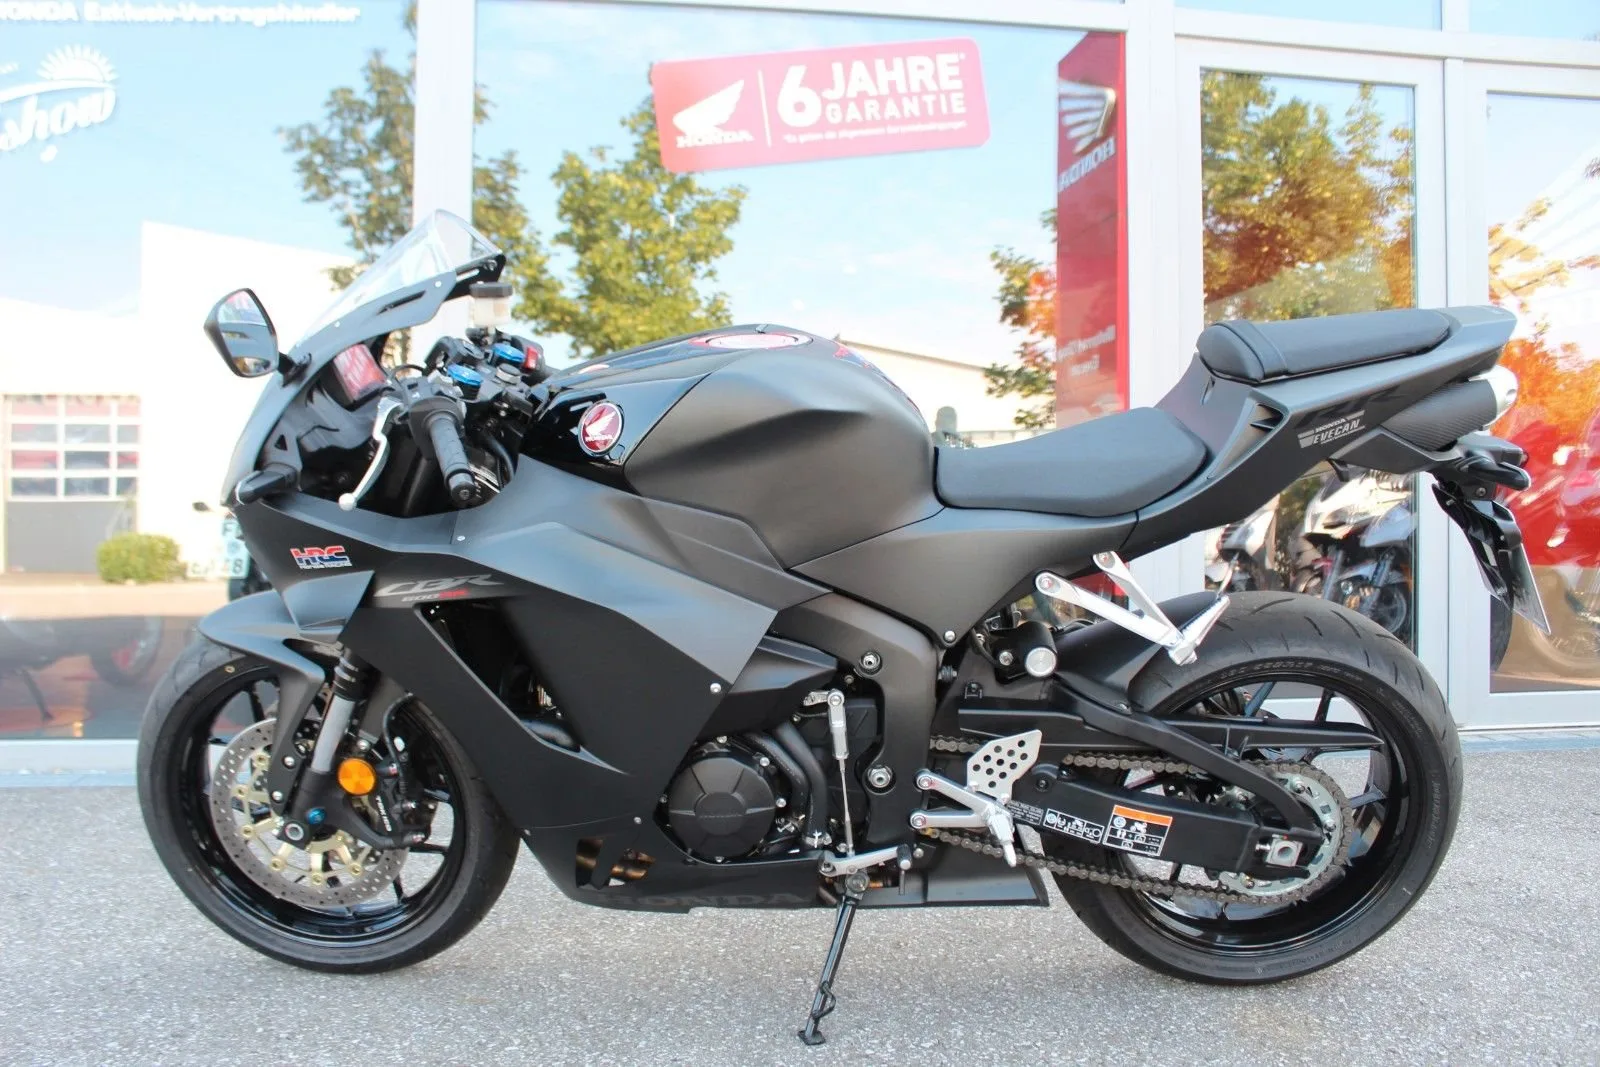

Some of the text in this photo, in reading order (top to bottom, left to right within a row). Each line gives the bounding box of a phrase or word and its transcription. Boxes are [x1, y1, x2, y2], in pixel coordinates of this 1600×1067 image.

[776, 64, 822, 128] 6
[825, 91, 967, 124] GARANTIE
[676, 130, 754, 148] HONDA
[1313, 419, 1360, 444] EVECAN
[290, 545, 349, 565] HRC
[373, 574, 505, 597] CBR
